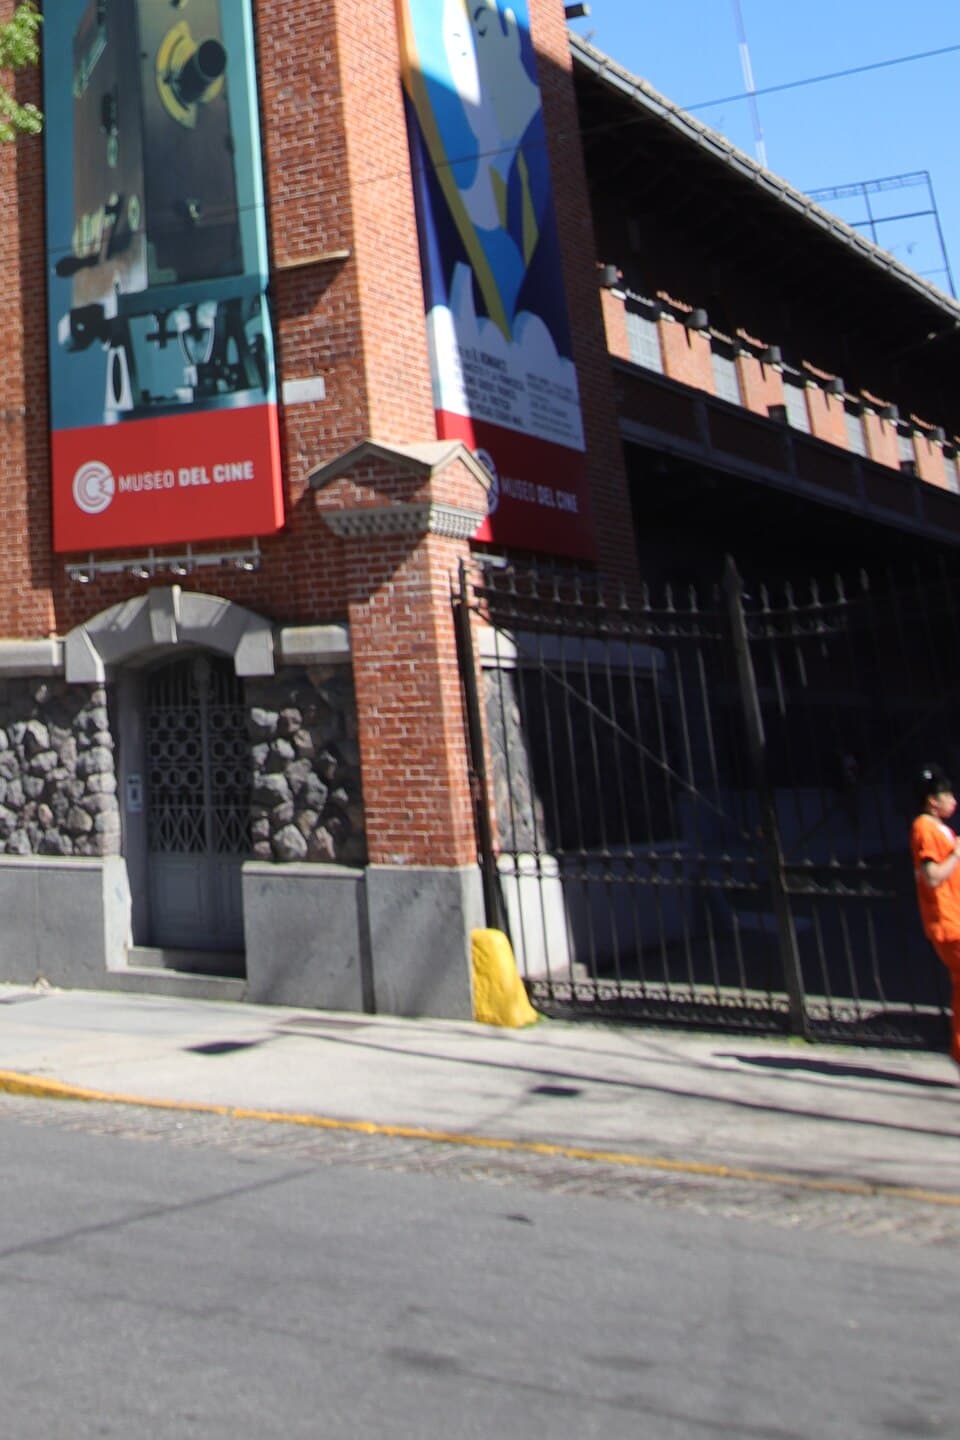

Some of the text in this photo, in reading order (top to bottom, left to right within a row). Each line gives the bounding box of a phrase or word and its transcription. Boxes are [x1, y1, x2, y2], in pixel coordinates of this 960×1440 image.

[118, 461, 254, 492] MUSEO DEL CINE
